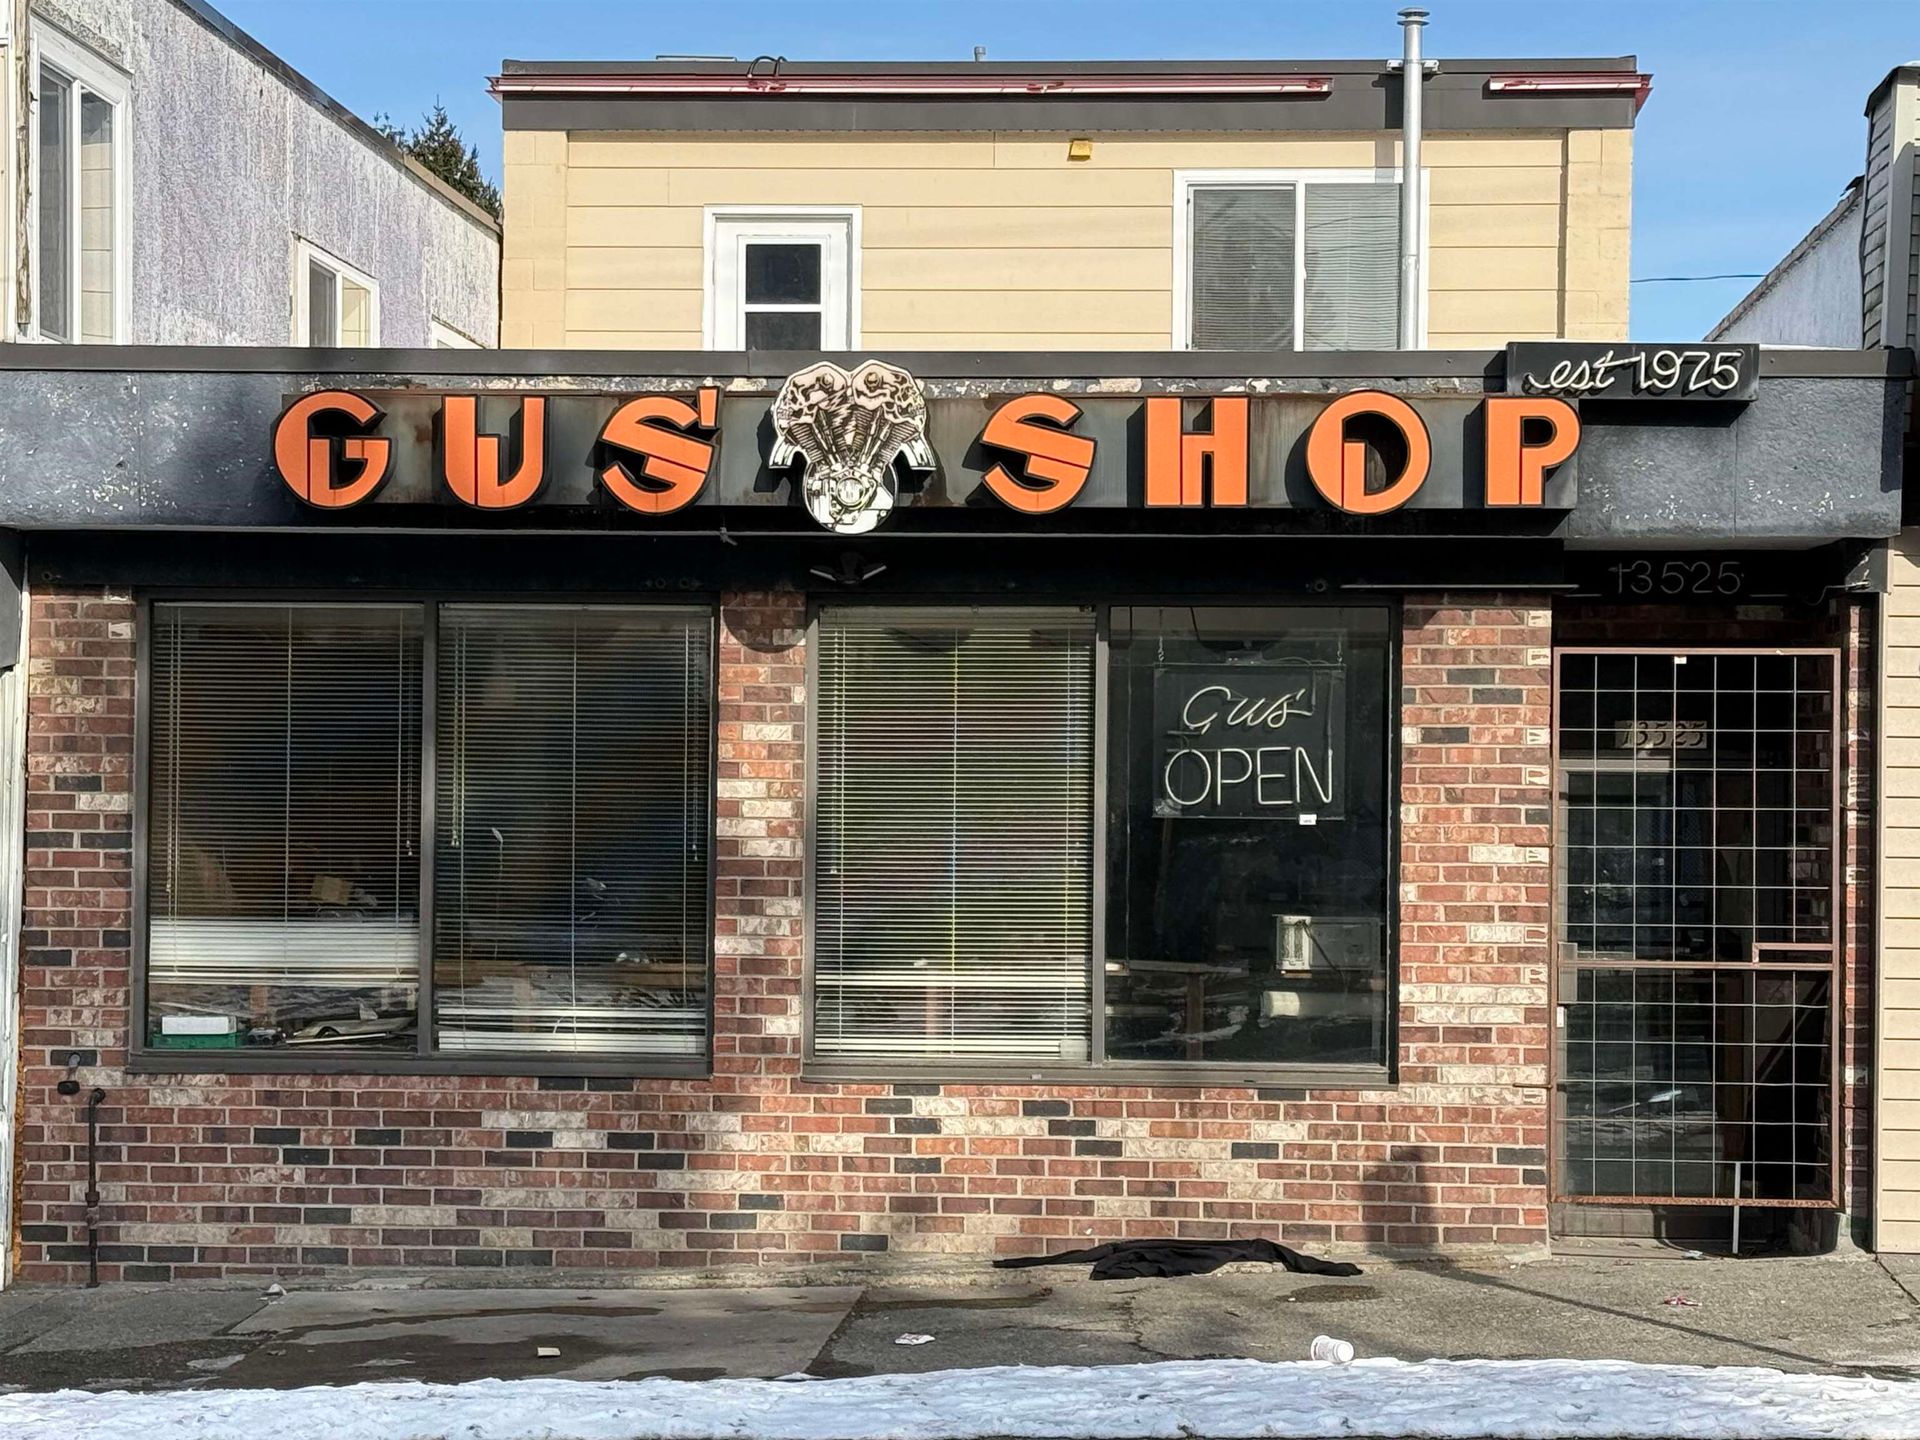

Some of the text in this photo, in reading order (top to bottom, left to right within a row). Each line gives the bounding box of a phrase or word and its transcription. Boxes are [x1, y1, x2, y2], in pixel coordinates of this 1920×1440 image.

[1528, 350, 1743, 391] est 1975
[274, 387, 1582, 515] GUS' SHOP
[1616, 560, 1741, 595] 13525
[1622, 721, 1705, 747] 13525
[1165, 747, 1333, 805] OPEN
